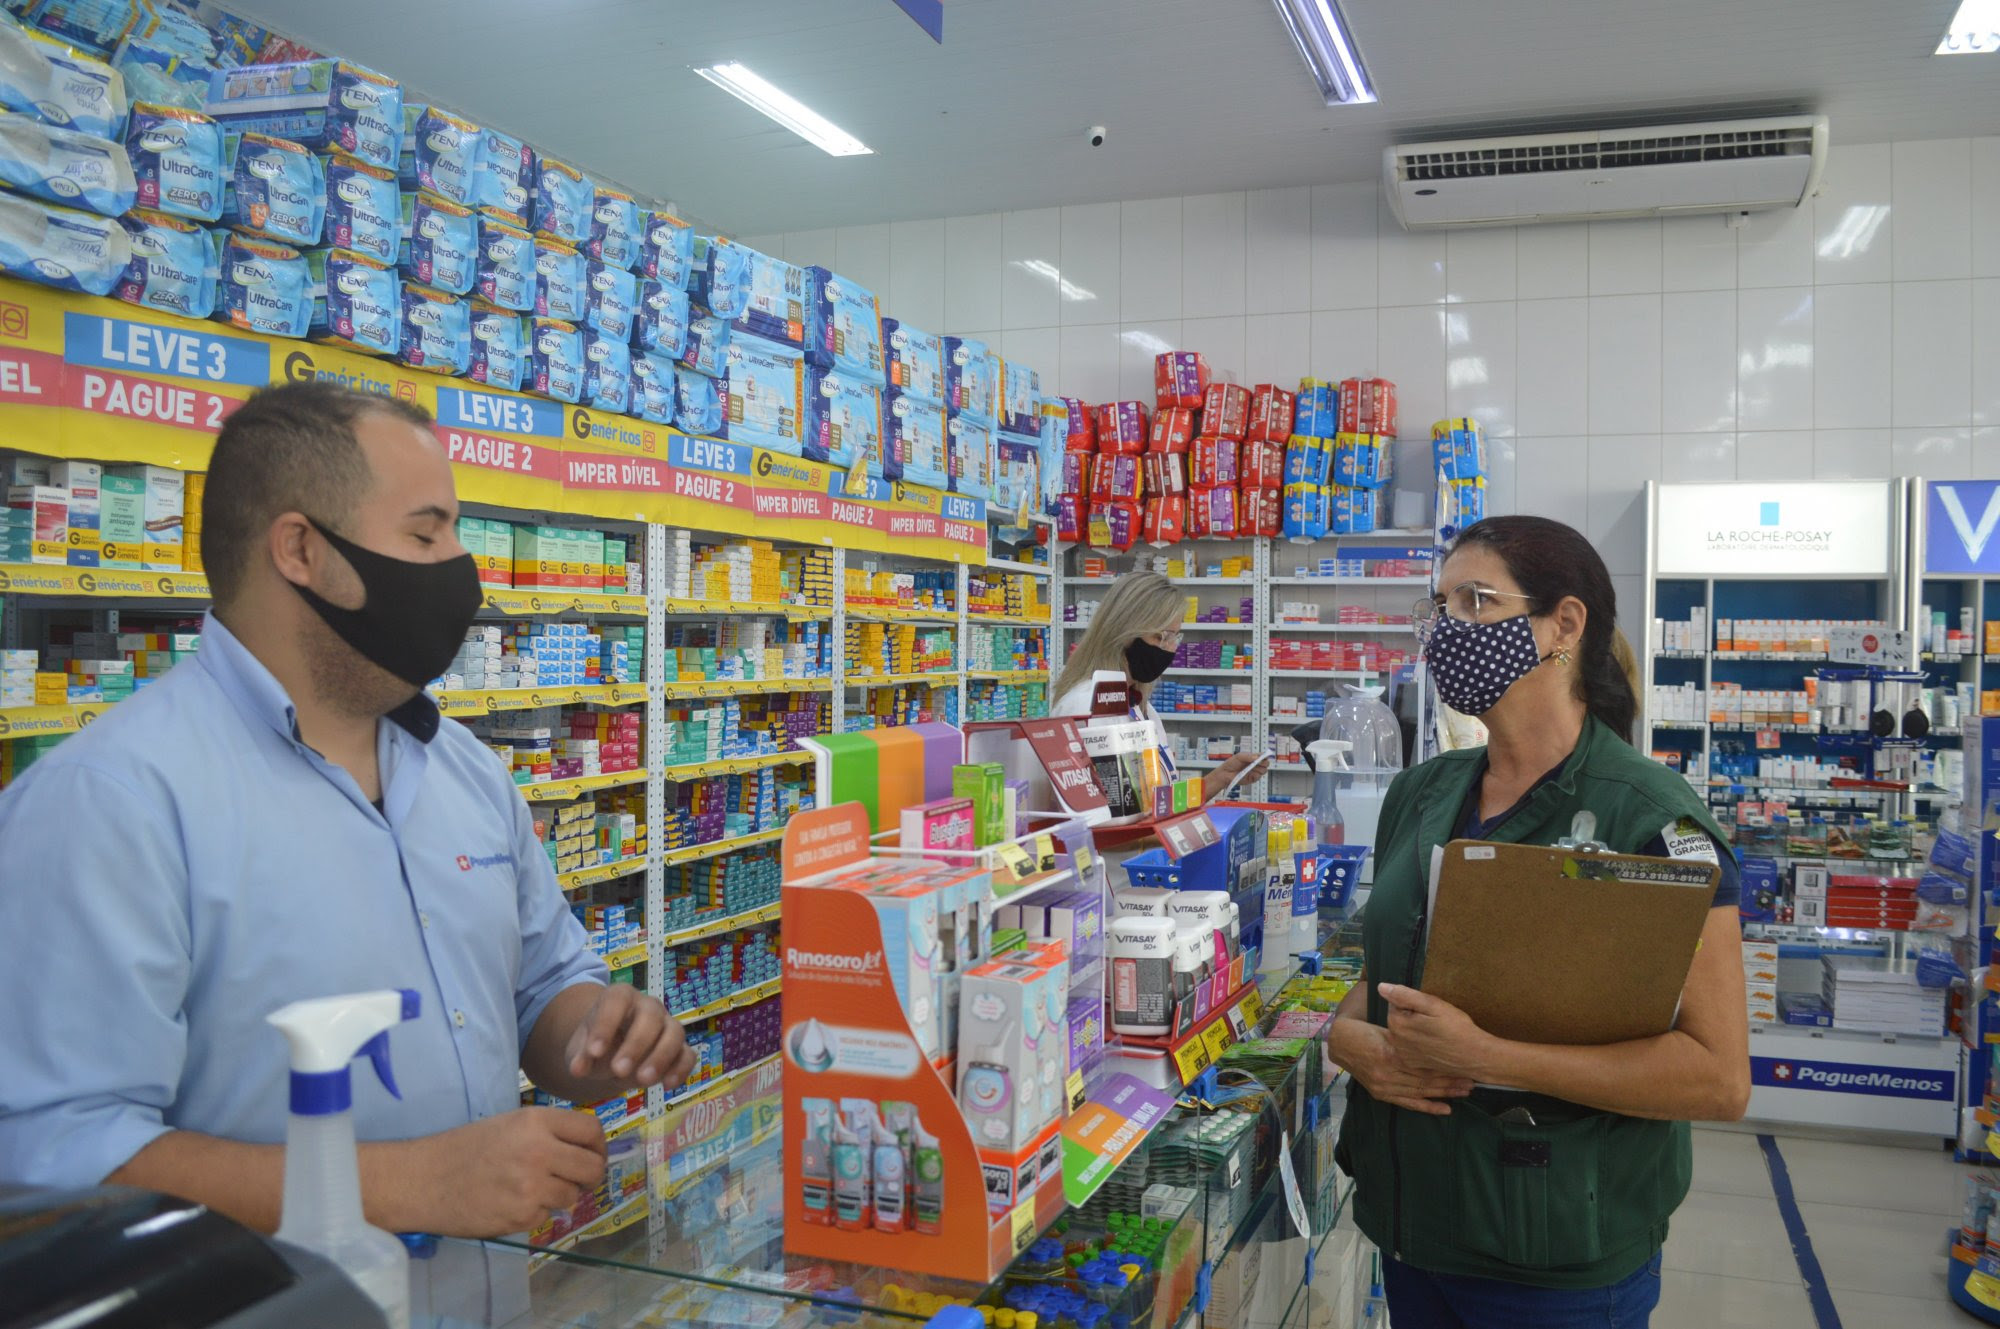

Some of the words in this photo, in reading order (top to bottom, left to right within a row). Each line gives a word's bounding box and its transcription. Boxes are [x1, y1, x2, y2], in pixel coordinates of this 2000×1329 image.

[341, 87, 383, 106] TENA
[143, 131, 188, 147] TENA
[161, 159, 214, 180] UltraCare
[250, 159, 285, 175] TENA
[53, 179, 75, 194] TENA
[169, 187, 199, 201] ZERO
[337, 180, 372, 199] TENA
[502, 190, 527, 205] TENA
[271, 212, 297, 225] ZERO
[596, 206, 624, 219] TENA
[353, 210, 392, 231] UltraCare
[421, 218, 446, 235] TENA
[359, 234, 380, 246] ZERO
[652, 229, 674, 242] TENA
[488, 245, 516, 259] TENA
[232, 263, 275, 282] TENA
[536, 259, 559, 272] TENA
[150, 264, 198, 286] UltraCare
[337, 274, 369, 289] TENA
[592, 275, 616, 289] TENA
[824, 284, 842, 298] TENA
[248, 291, 293, 312] UltraCare
[601, 295, 630, 314] UltraCare
[353, 300, 392, 319] UltraCare
[411, 307, 442, 322] TENA
[254, 318, 278, 330] ZERO
[362, 323, 381, 336] ZERO
[476, 323, 501, 336] TENA
[538, 336, 562, 349] TENA
[891, 332, 908, 345] TENA
[102, 319, 201, 376] LEVE
[206, 342, 226, 381] 3
[588, 345, 611, 357] TENA
[549, 358, 577, 375] UltraCare
[748, 356, 775, 369] UltraCare
[820, 379, 841, 393] TENA
[83, 374, 196, 425] PAGUE
[206, 396, 225, 428] 2
[892, 400, 910, 412] TENA
[457, 390, 517, 431] LEVE
[520, 404, 534, 433] 3
[449, 433, 515, 470] PAGUE
[522, 446, 533, 471] 2
[682, 437, 724, 471] LEVE
[726, 447, 736, 472] 3
[675, 471, 722, 501] PAGUE
[725, 481, 734, 502] 2
[832, 501, 864, 524] PAGUE
[866, 508, 873, 525] 2
[948, 496, 970, 518] LEVE
[969, 501, 975, 520] 3
[944, 521, 968, 542] PAGUE
[968, 526, 974, 542] 2
[1935, 485, 2000, 565] V
[69, 532, 80, 545] G
[1707, 530, 1726, 543] LA
[1730, 530, 1833, 543] ROCHE-POSAY
[102, 542, 117, 559] G
[1052, 766, 1092, 791] VITASAY
[1668, 835, 1710, 850] CAMPINA
[1673, 843, 1713, 857] GRANDE
[1118, 902, 1154, 912] VITASAY
[1172, 904, 1209, 914] VITASAY
[1115, 934, 1157, 944] VITASAY
[1797, 1066, 1943, 1092] PagueMenos
